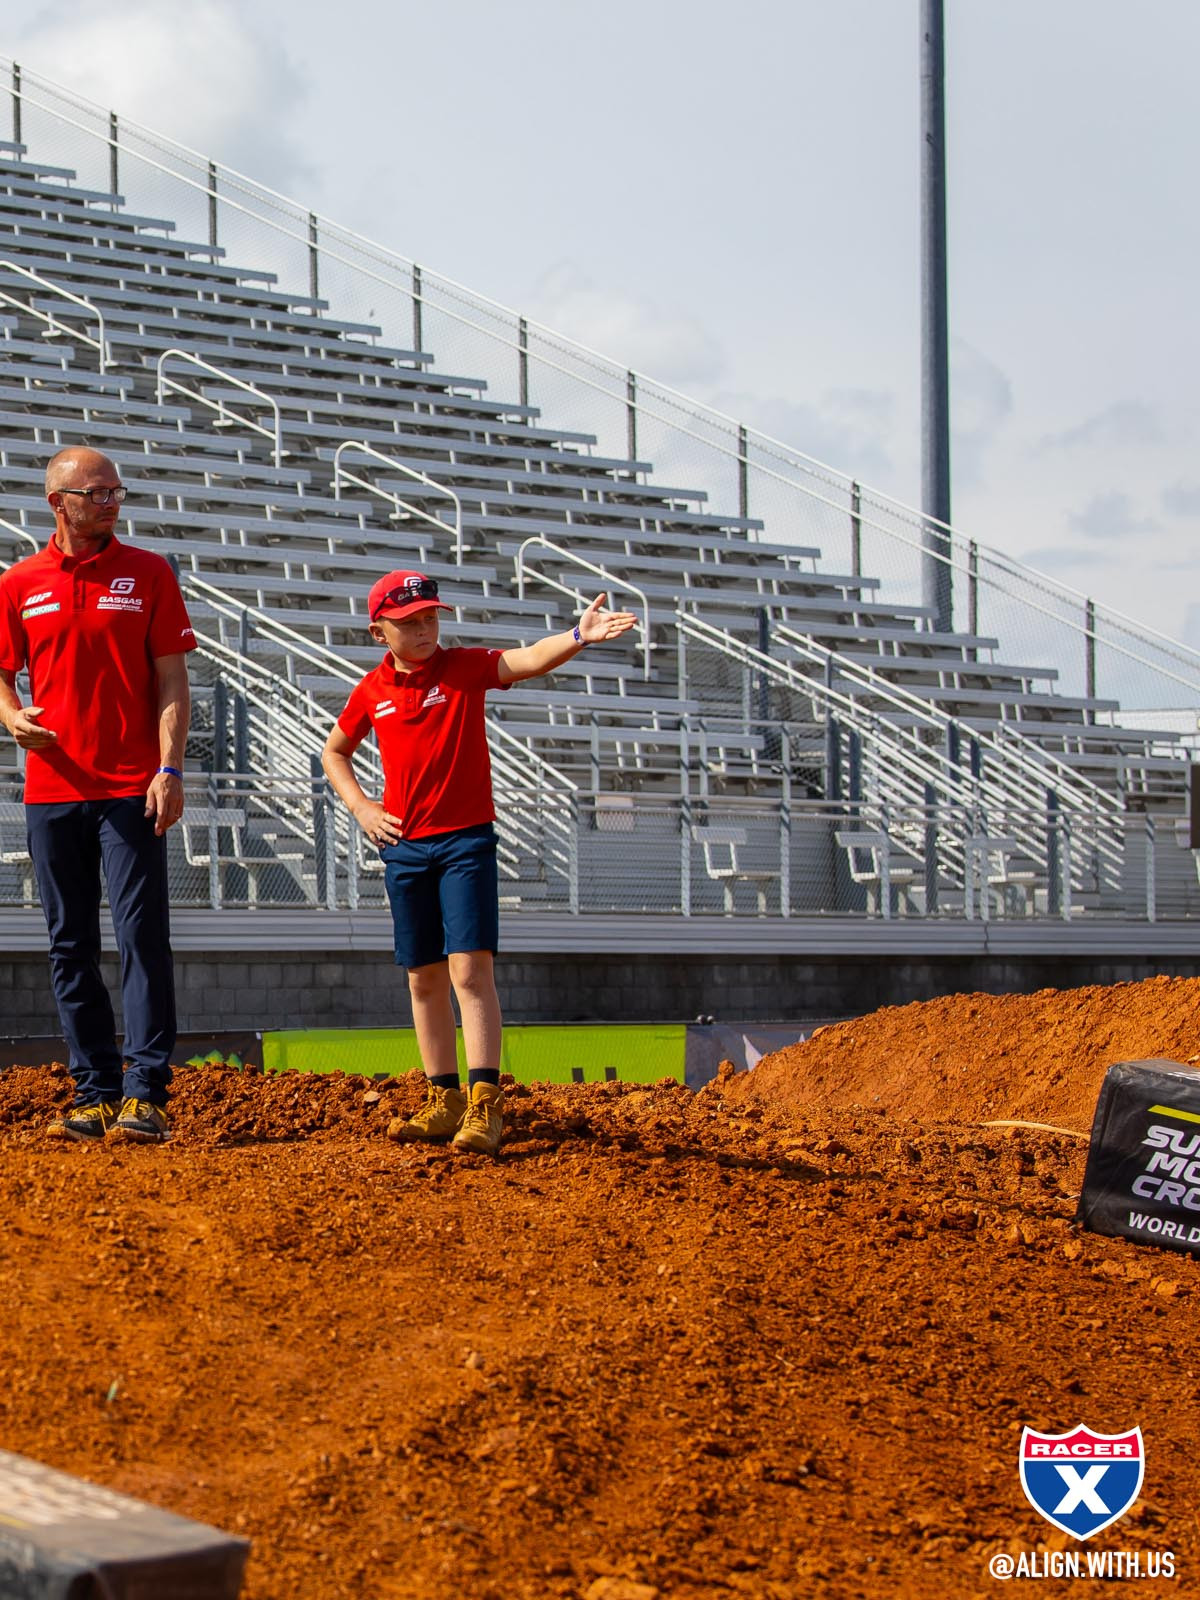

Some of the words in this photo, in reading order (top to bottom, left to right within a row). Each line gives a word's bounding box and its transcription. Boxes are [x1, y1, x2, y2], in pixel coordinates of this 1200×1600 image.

[98, 596, 142, 606] GASGAS
[1141, 1124, 1200, 1157] SU
[1128, 1211, 1200, 1243] WORLD
